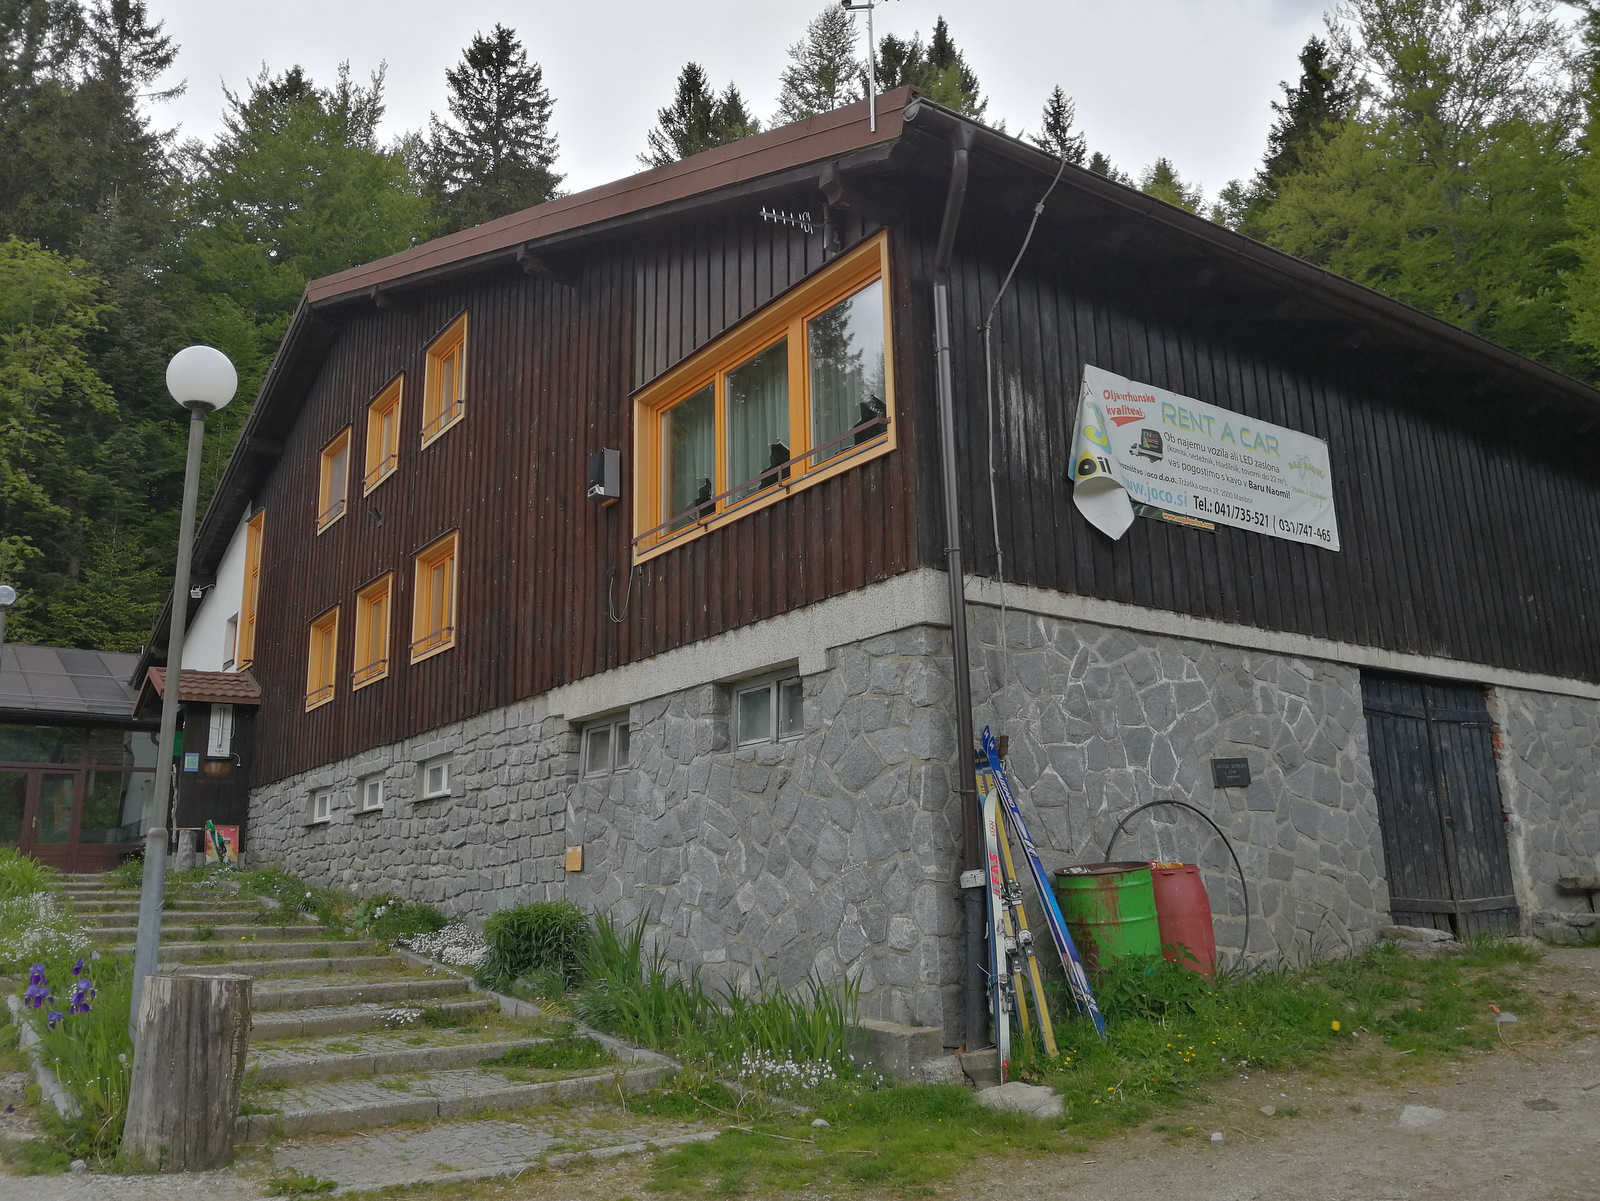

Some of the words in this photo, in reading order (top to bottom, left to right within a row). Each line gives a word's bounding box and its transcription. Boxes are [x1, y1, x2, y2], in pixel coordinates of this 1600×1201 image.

[1161, 401, 1216, 438] RENT
[1221, 422, 1237, 446] A
[1240, 426, 1281, 458] CAR
[1163, 431, 1176, 444] Ob
[1177, 437, 1206, 452] najemu
[1207, 445, 1229, 459] vozila
[1230, 451, 1239, 462] ali
[1239, 453, 1254, 466] LED
[1254, 459, 1280, 474] zaslona
[1168, 458, 1180, 469] vas
[1181, 461, 1220, 480] pogostimo
[1226, 473, 1243, 487] kavo
[1248, 480, 1265, 493] Baru
[1265, 485, 1291, 500] Naomi!
[1220, 489, 1233, 500] 2000
[1241, 467, 1261, 479] tovorni
[1261, 471, 1270, 481] do
[1269, 474, 1277, 483] 22
[1192, 495, 1212, 512] Tel.:
[1214, 501, 1269, 528] 041/735-521
[1278, 518, 1331, 542] 031/747-465
